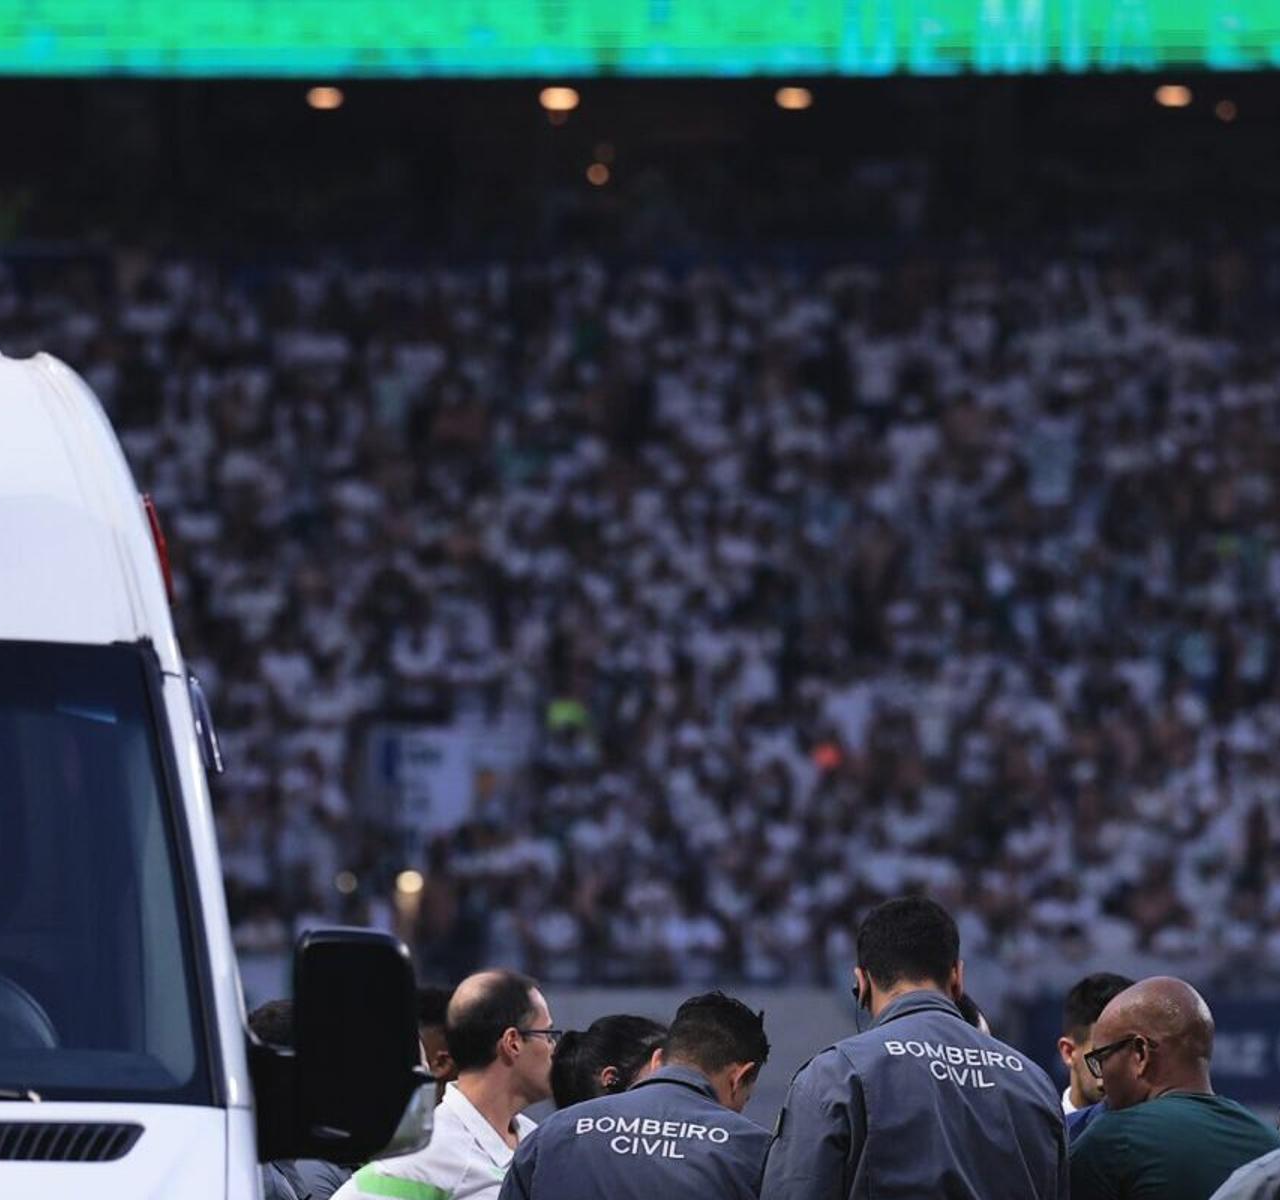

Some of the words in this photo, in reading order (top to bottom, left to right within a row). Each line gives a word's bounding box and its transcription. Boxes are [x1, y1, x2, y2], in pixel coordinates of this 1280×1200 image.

[884, 1039, 1025, 1072] BOMBEIRO
[929, 1060, 995, 1089] CIVIL
[575, 1116, 730, 1144] BOMBEIRO
[609, 1135, 685, 1159] CIVIL
